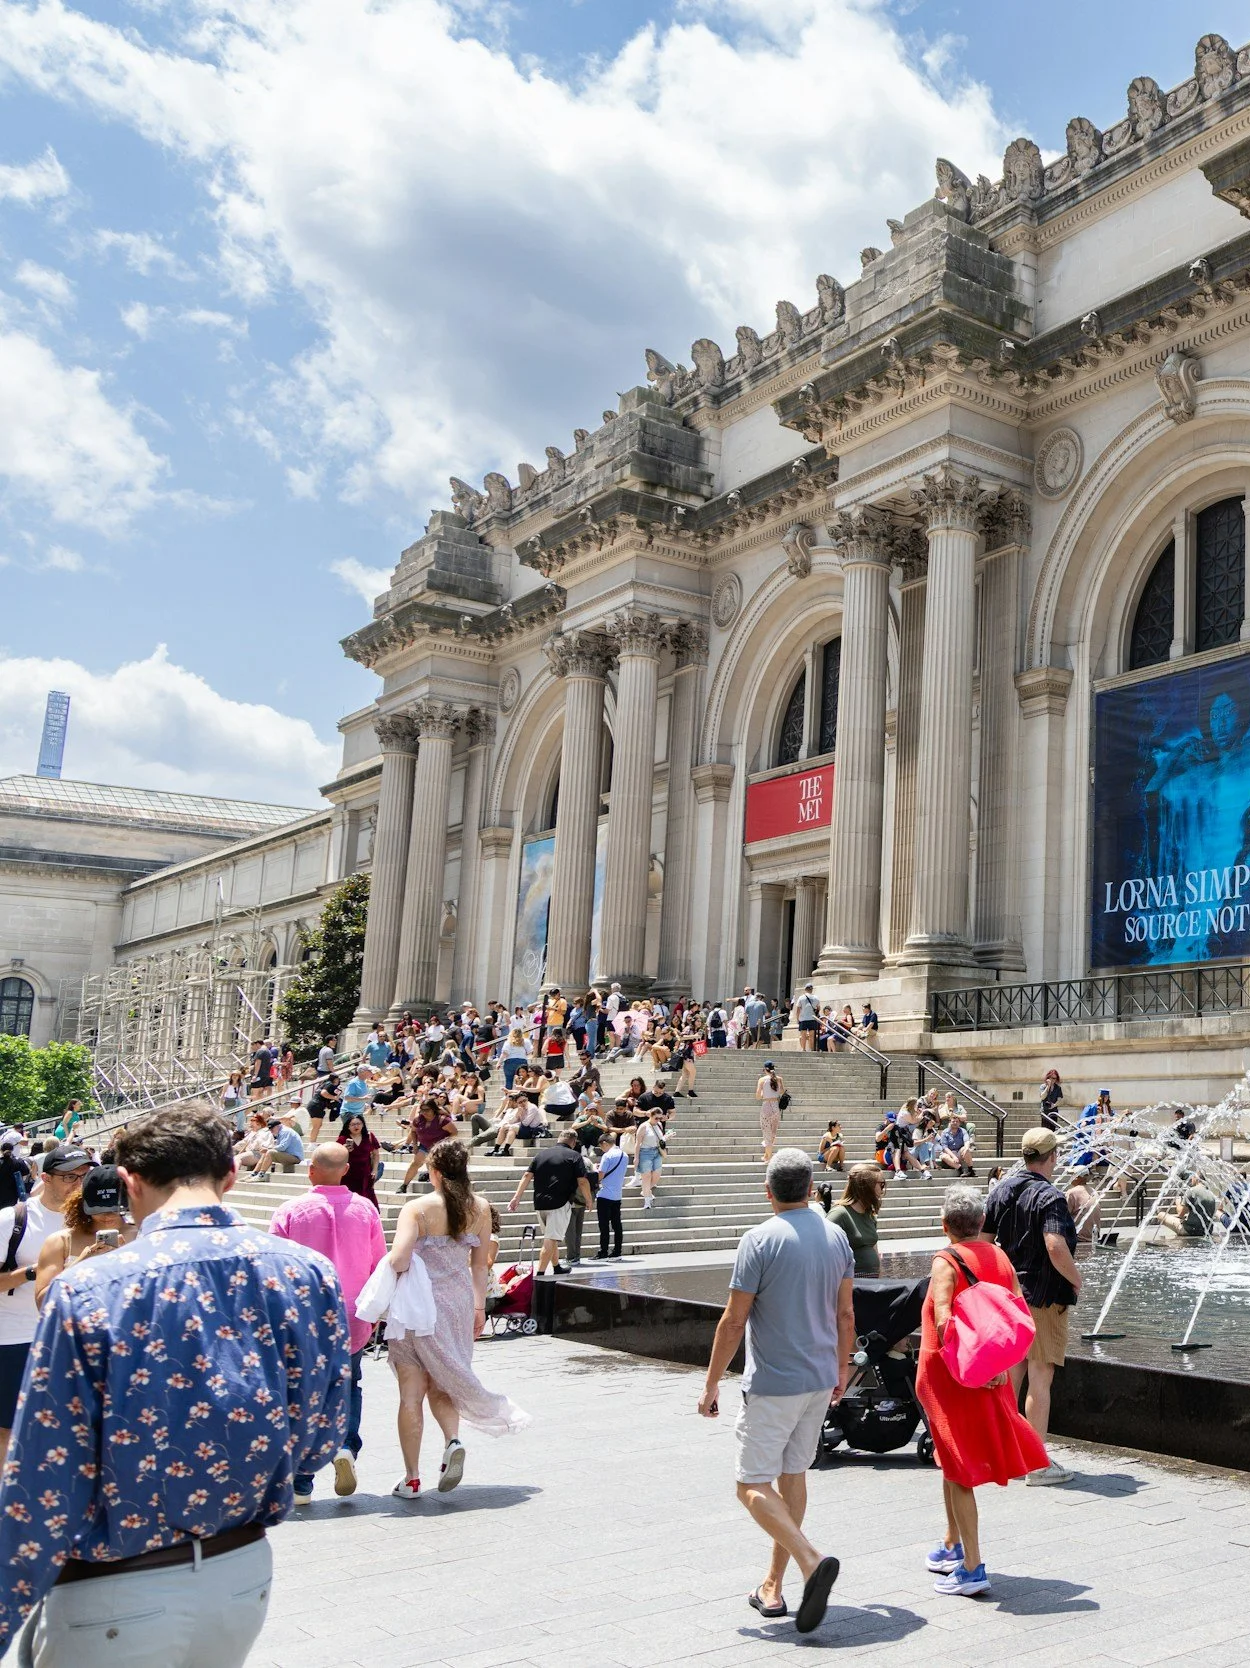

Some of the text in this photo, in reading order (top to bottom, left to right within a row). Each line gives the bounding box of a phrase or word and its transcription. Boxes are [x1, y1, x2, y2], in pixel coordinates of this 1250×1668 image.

[799, 775, 822, 800] THE
[797, 798, 823, 824] MET
[1103, 874, 1179, 914] LORNA
[1124, 910, 1200, 943] SOURCE
